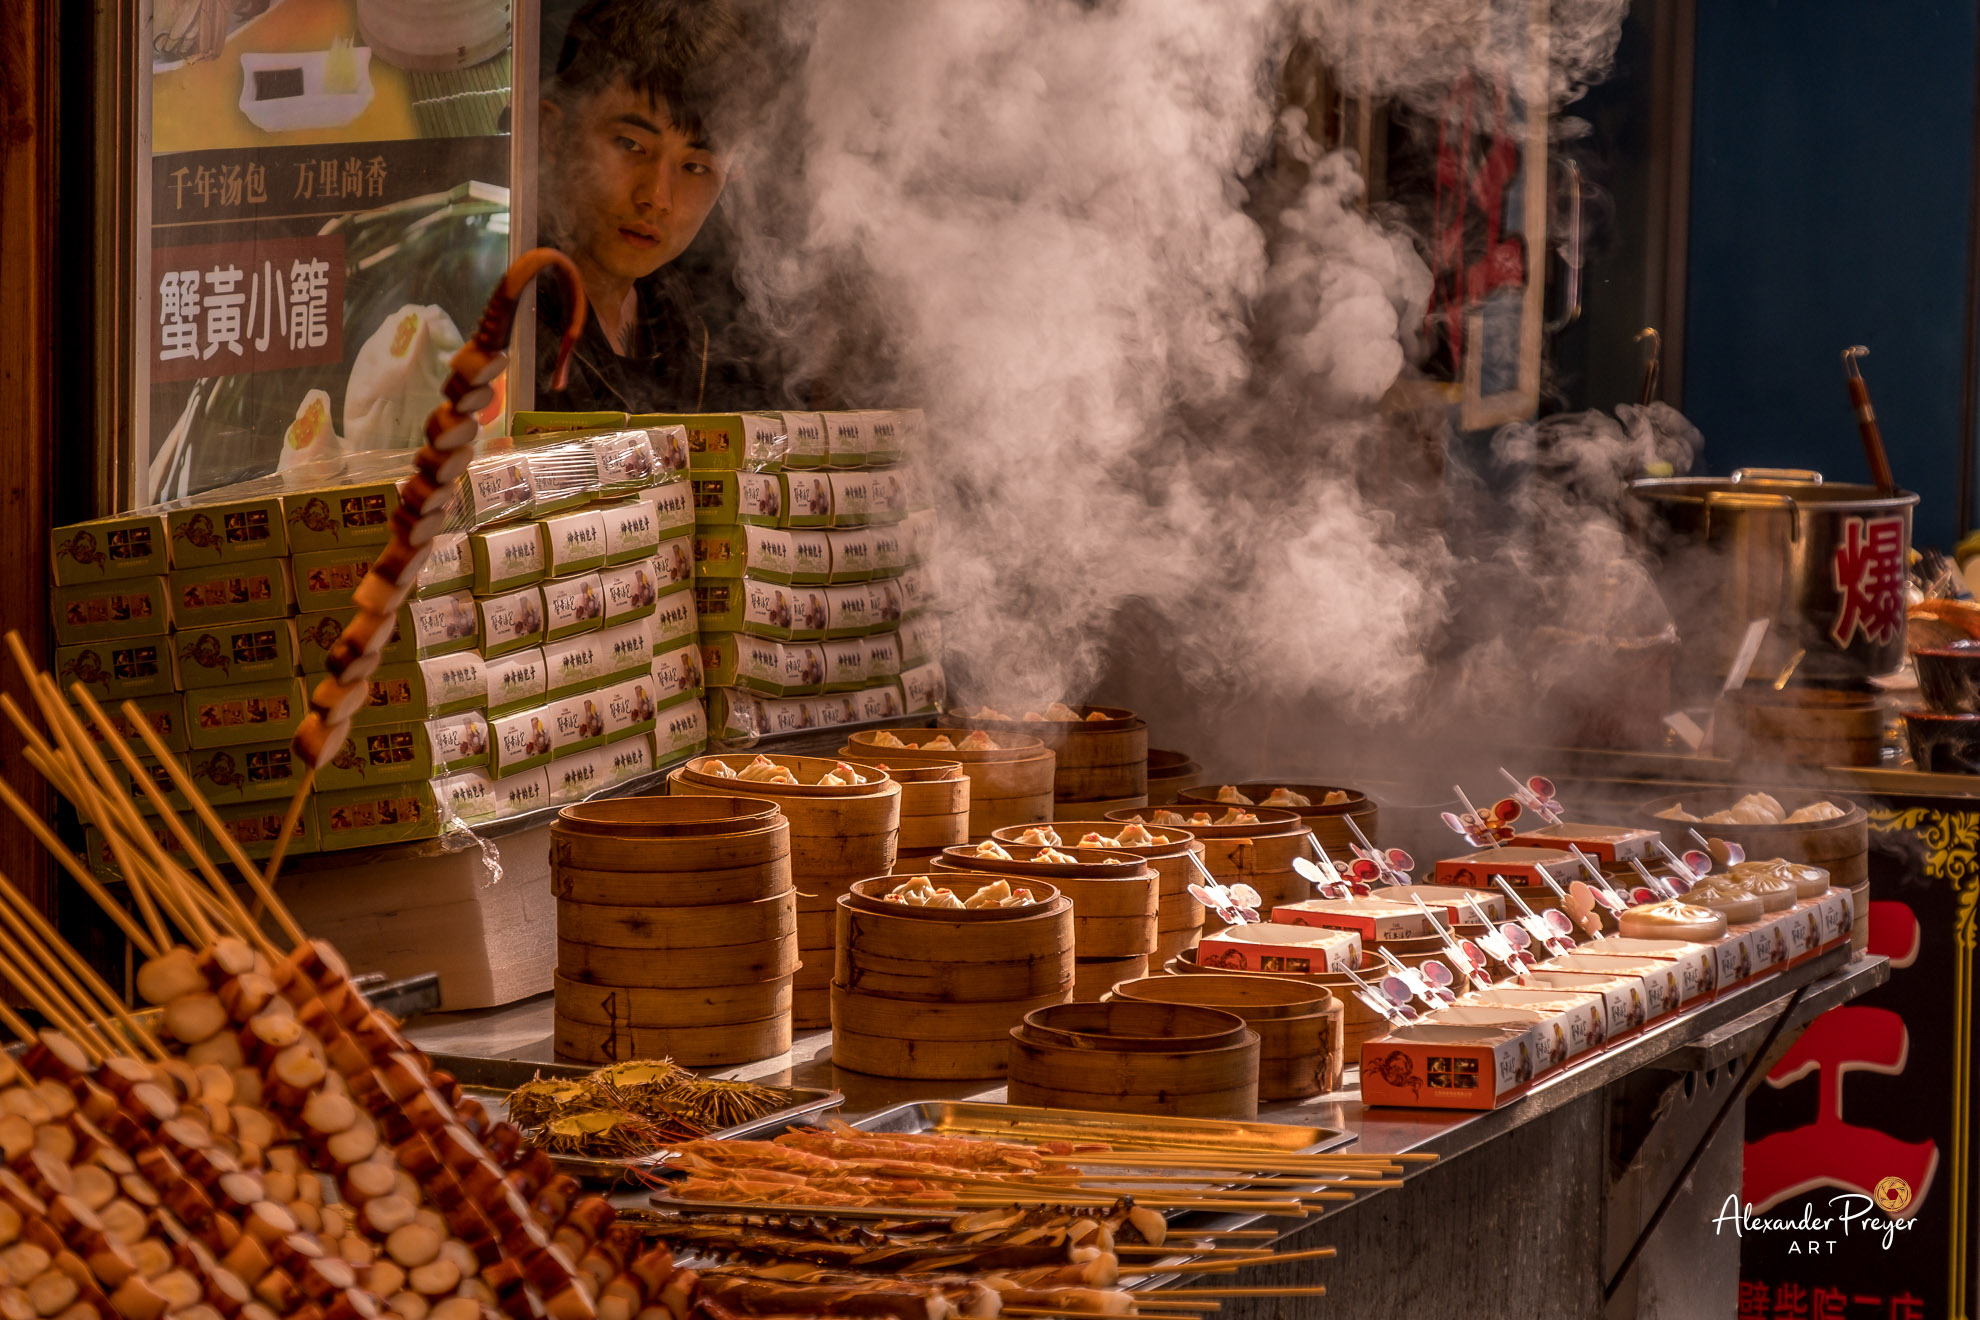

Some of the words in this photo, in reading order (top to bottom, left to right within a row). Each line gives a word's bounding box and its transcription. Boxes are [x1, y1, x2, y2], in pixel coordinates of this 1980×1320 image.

[168, 161, 268, 210] 千年汤包
[293, 155, 388, 200] 万里尚香
[1833, 517, 1906, 649] 爆
